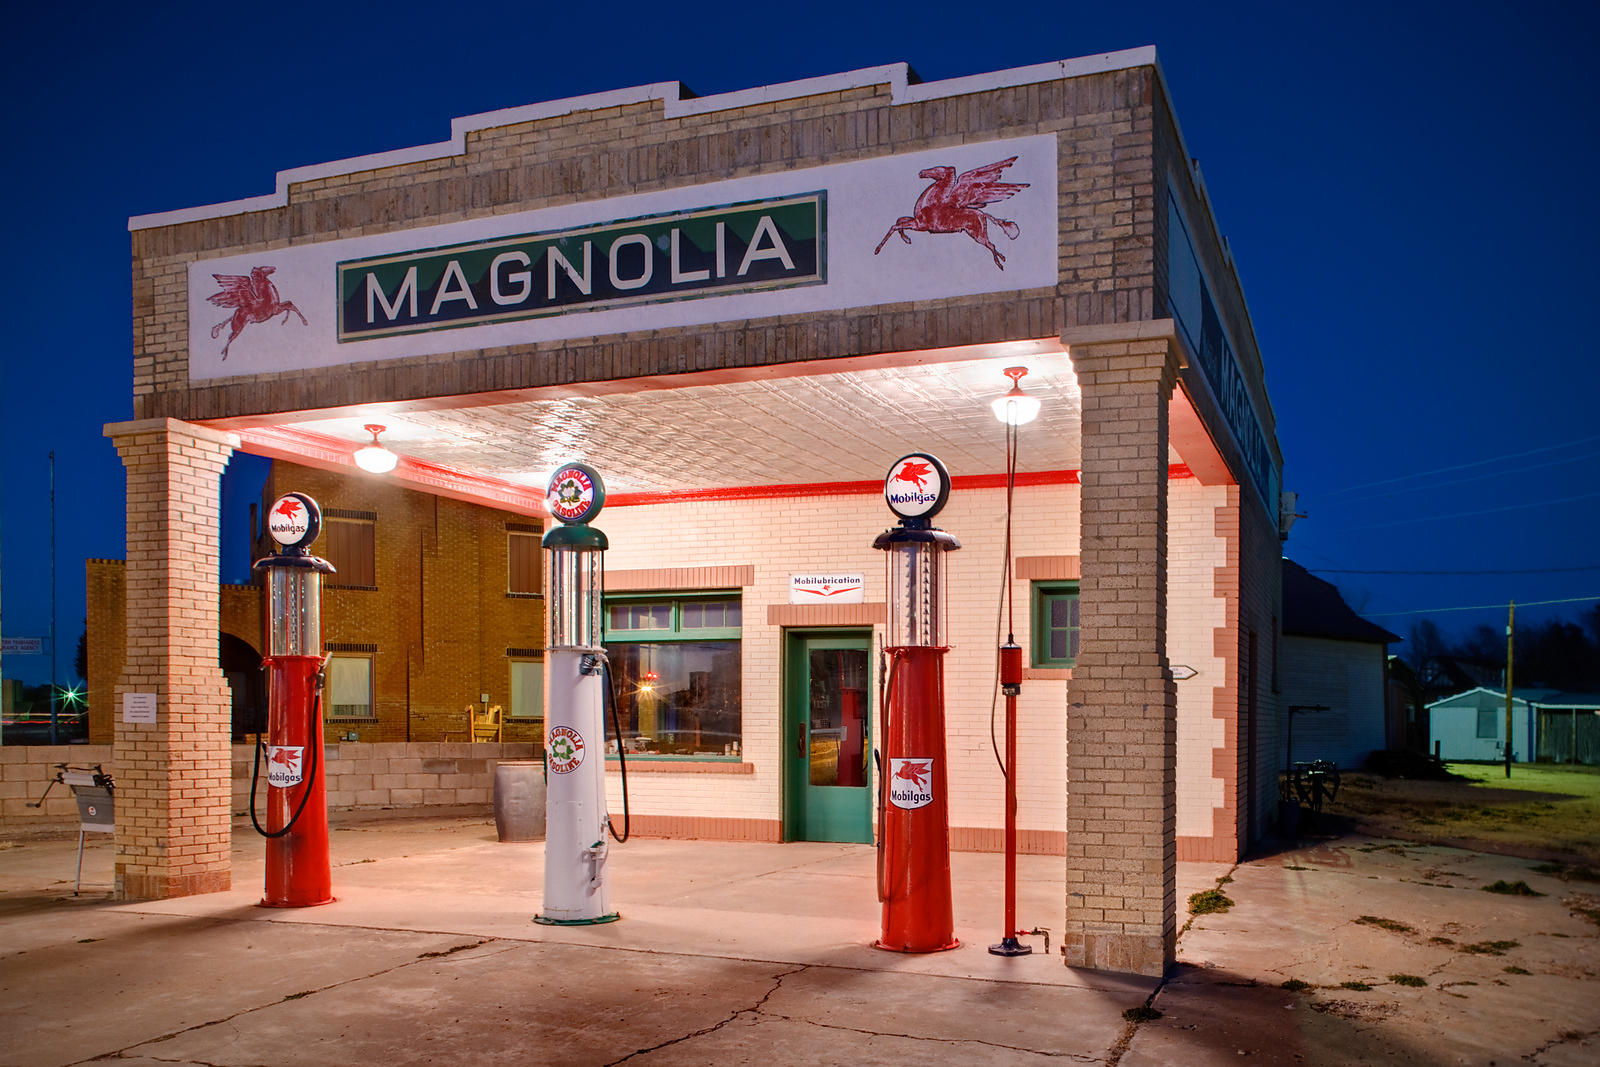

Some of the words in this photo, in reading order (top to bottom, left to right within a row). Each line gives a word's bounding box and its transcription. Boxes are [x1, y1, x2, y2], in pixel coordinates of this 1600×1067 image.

[366, 214, 796, 324] MAGNOLIA
[552, 470, 592, 492] MAGNOLIA
[890, 492, 936, 505] Mobilgas
[553, 499, 592, 518] GASOLINE
[271, 524, 306, 535] Mobilgas
[549, 728, 584, 752] MAGNOLIA
[891, 790, 931, 804] Mobilgas
